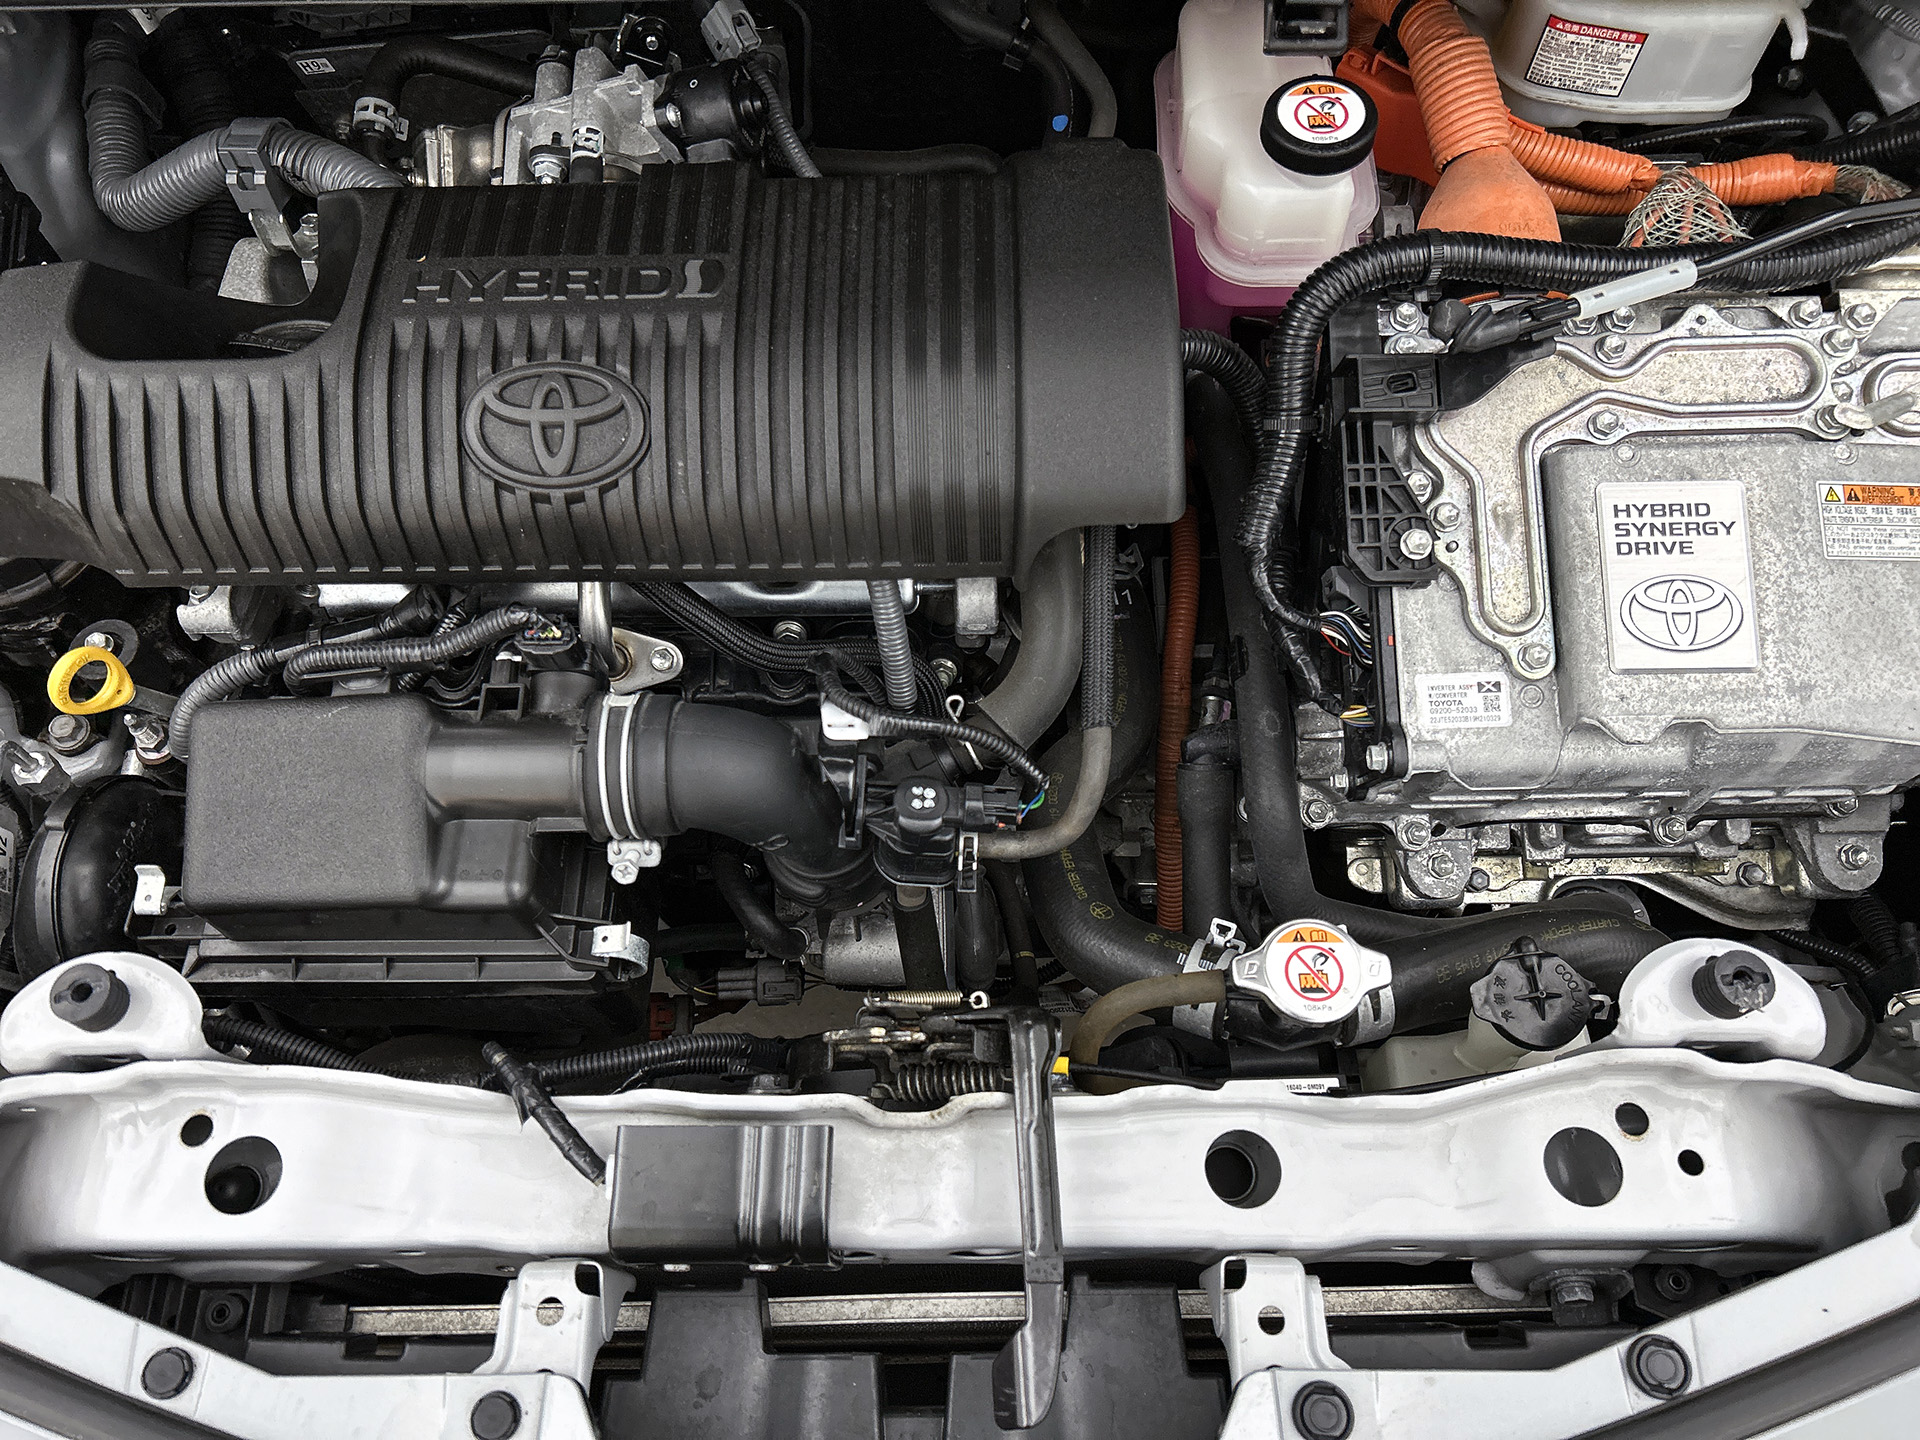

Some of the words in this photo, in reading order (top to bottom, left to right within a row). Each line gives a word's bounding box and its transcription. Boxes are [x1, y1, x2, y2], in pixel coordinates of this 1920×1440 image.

[1580, 27, 1620, 40] DANGER
[402, 266, 672, 302] HYBRID
[1613, 502, 1711, 518] HYBRID
[1614, 521, 1736, 537] SYNERGY
[1616, 541, 1694, 556] DRIVE
[1554, 963, 1585, 1025] COOLANT
[1303, 1004, 1333, 1012] 108kPa
